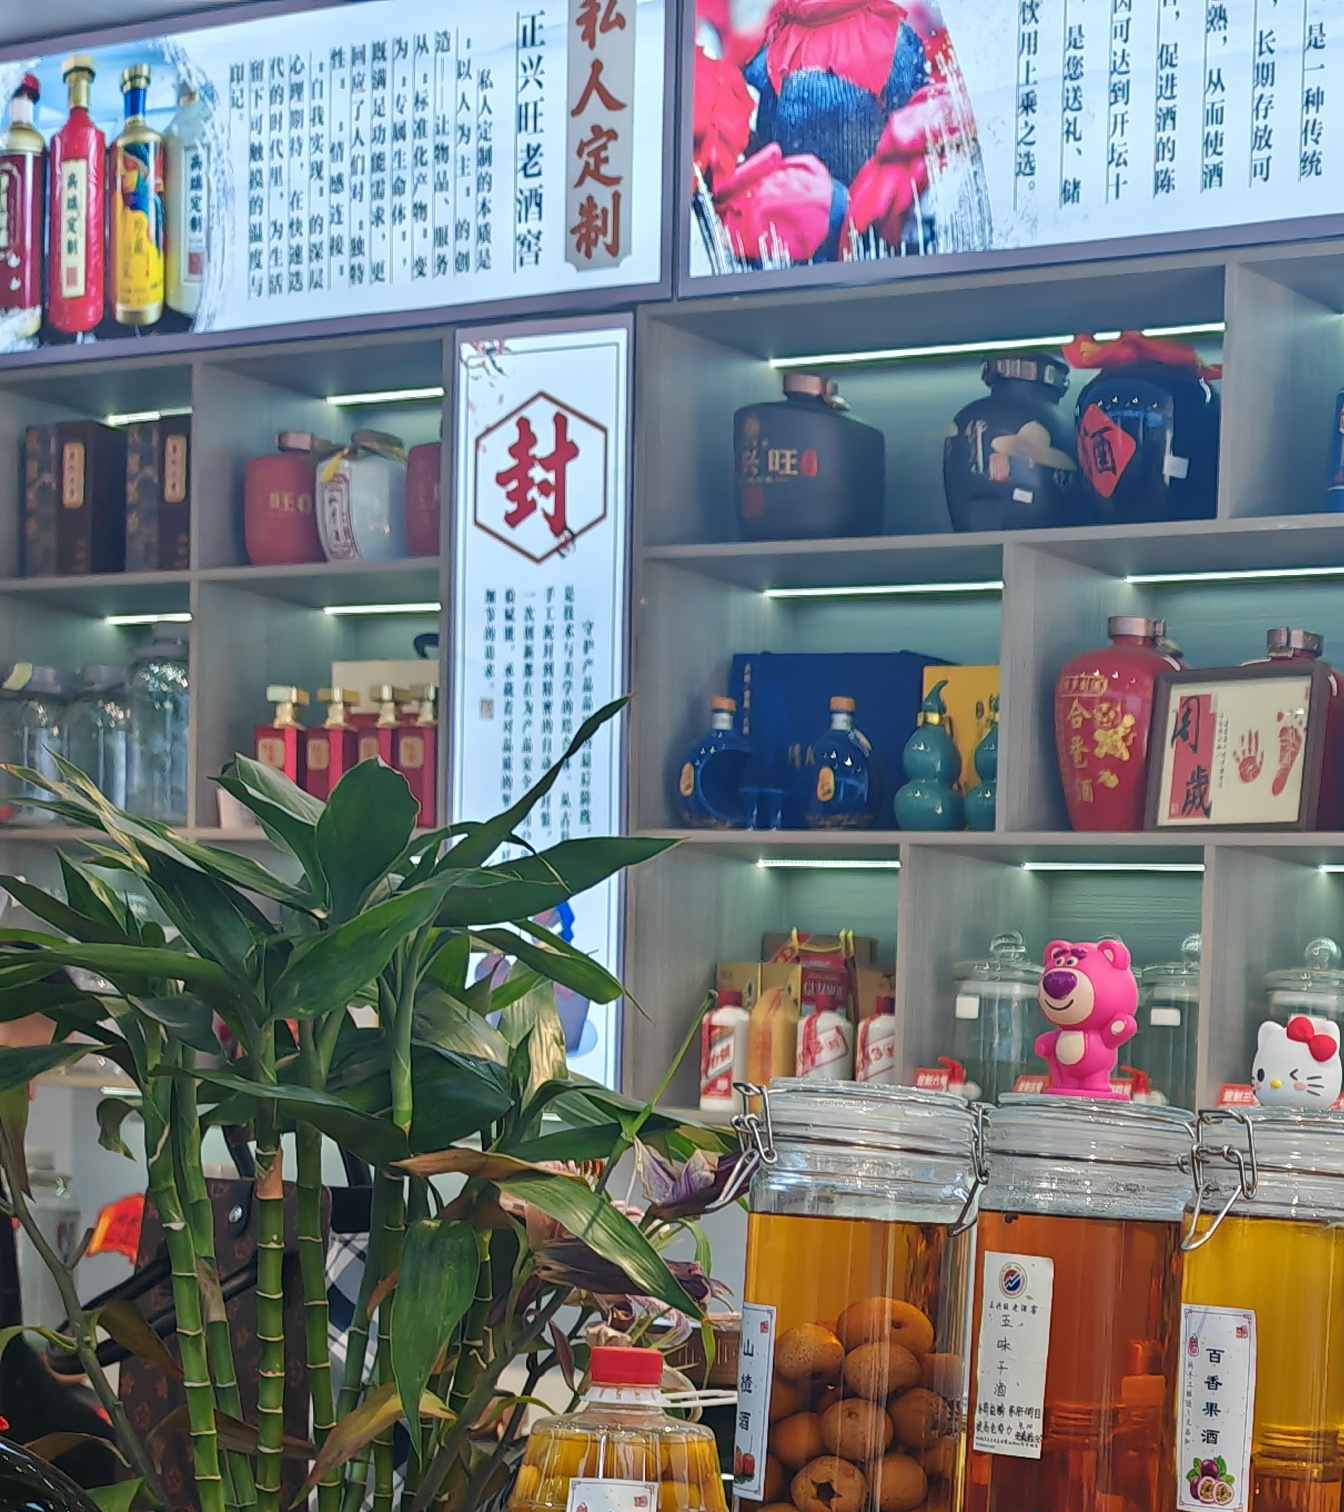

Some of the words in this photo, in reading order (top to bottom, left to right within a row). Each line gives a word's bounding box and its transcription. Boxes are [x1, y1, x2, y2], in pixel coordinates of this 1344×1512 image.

[516, 11, 546, 268] 正兴旺老酒窖
[570, 0, 627, 260] 私人定制
[495, 412, 580, 538] 封
[994, 1315, 1012, 1398] 五味子酒
[1201, 1347, 1225, 1445] 百香果酒
